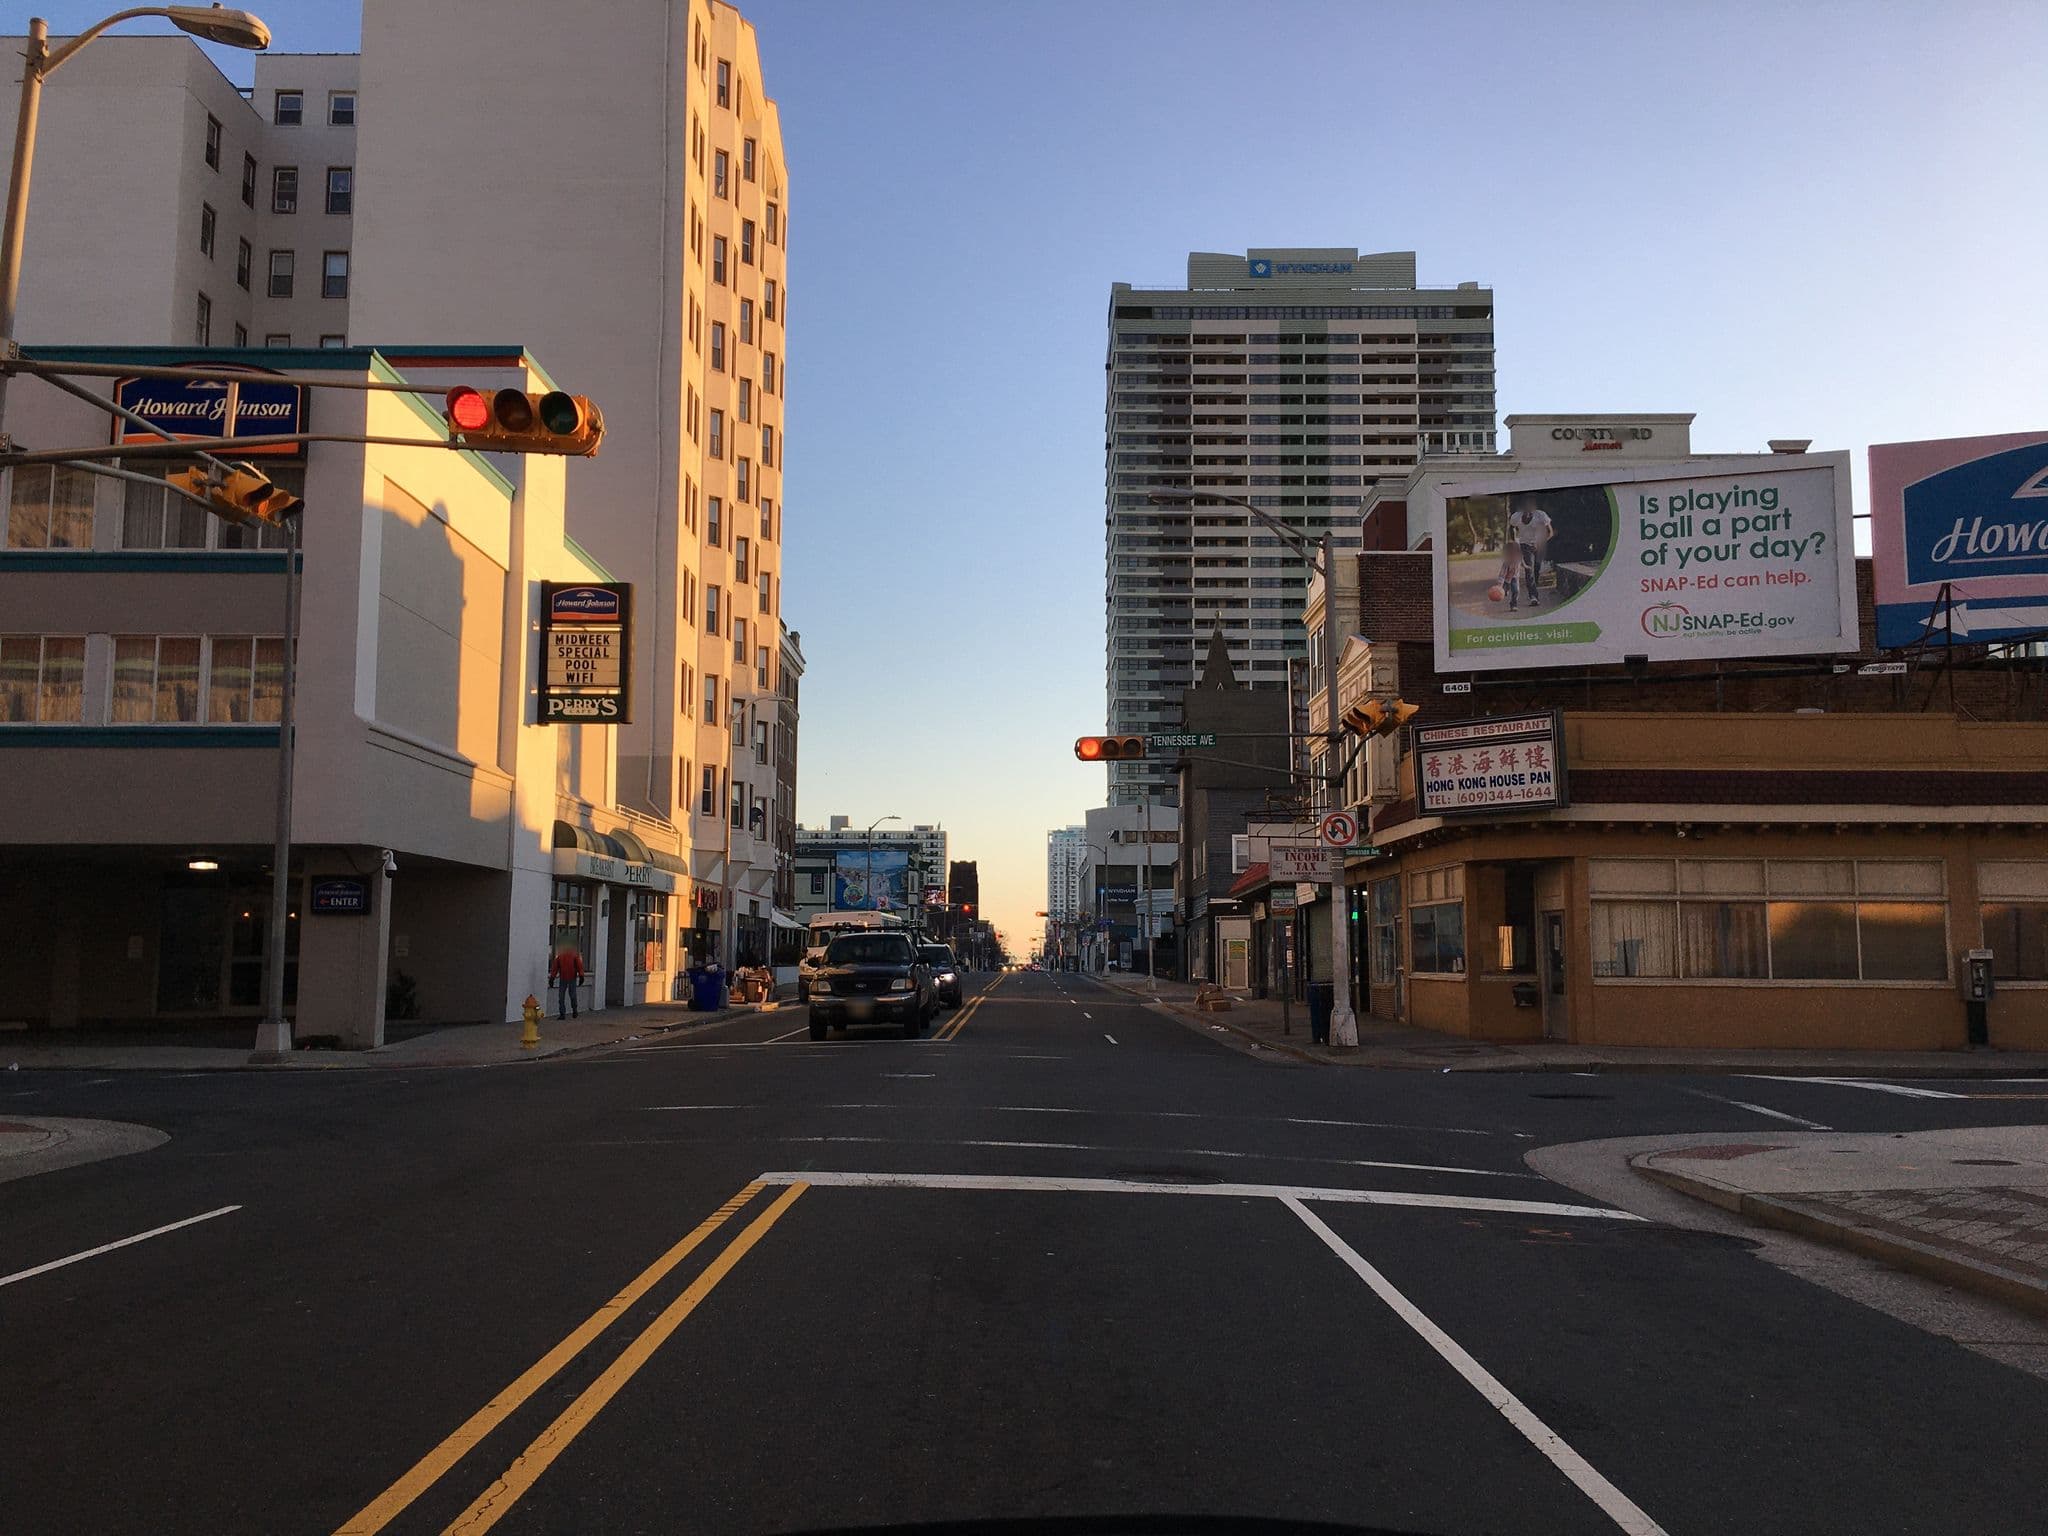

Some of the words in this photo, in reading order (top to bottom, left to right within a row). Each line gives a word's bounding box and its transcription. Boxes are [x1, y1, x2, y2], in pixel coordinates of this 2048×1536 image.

[1276, 263, 1352, 273] WYNDHAM
[128, 398, 210, 416] Howard
[208, 398, 292, 421] Jhnson
[1639, 495, 1659, 514] Is
[1668, 485, 1778, 517] playing
[1640, 515, 1692, 540] ball
[1702, 518, 1720, 536] a
[1732, 508, 1792, 539] part
[1640, 543, 1668, 566] of
[1675, 543, 1741, 569] your
[1750, 532, 1826, 561] day?
[1641, 574, 1718, 592] SNAP-Ed
[1724, 575, 1760, 587] can
[1765, 569, 1811, 586] help.
[556, 599, 585, 607] Howard
[585, 599, 615, 608] Johnson
[555, 634, 610, 645] MIDWEEK
[1467, 634, 1483, 643] For
[1547, 630, 1573, 639] visit:
[558, 647, 609, 658] SPECIAL
[565, 660, 597, 670] POOL
[566, 672, 594, 683] WIFI
[1445, 684, 1469, 692] 6405
[547, 697, 618, 716] PERRY'S
[1423, 728, 1468, 741] CHINESE
[1473, 719, 1548, 736] RESTAURANT
[1152, 734, 1197, 746] TENNESSEE
[1200, 734, 1216, 746] AVE.
[1426, 745, 1550, 778] 香港海鮮樓
[1426, 780, 1454, 793] HONG
[1458, 777, 1486, 790] KONG
[1489, 773, 1525, 787] HOUSE
[1530, 771, 1551, 784] PAN
[1428, 794, 1450, 805] TEL:
[1457, 787, 1552, 804] (609)344-1644
[1285, 852, 1328, 862] INCOME
[1295, 862, 1317, 872] TAX
[330, 897, 359, 906] ENTER
